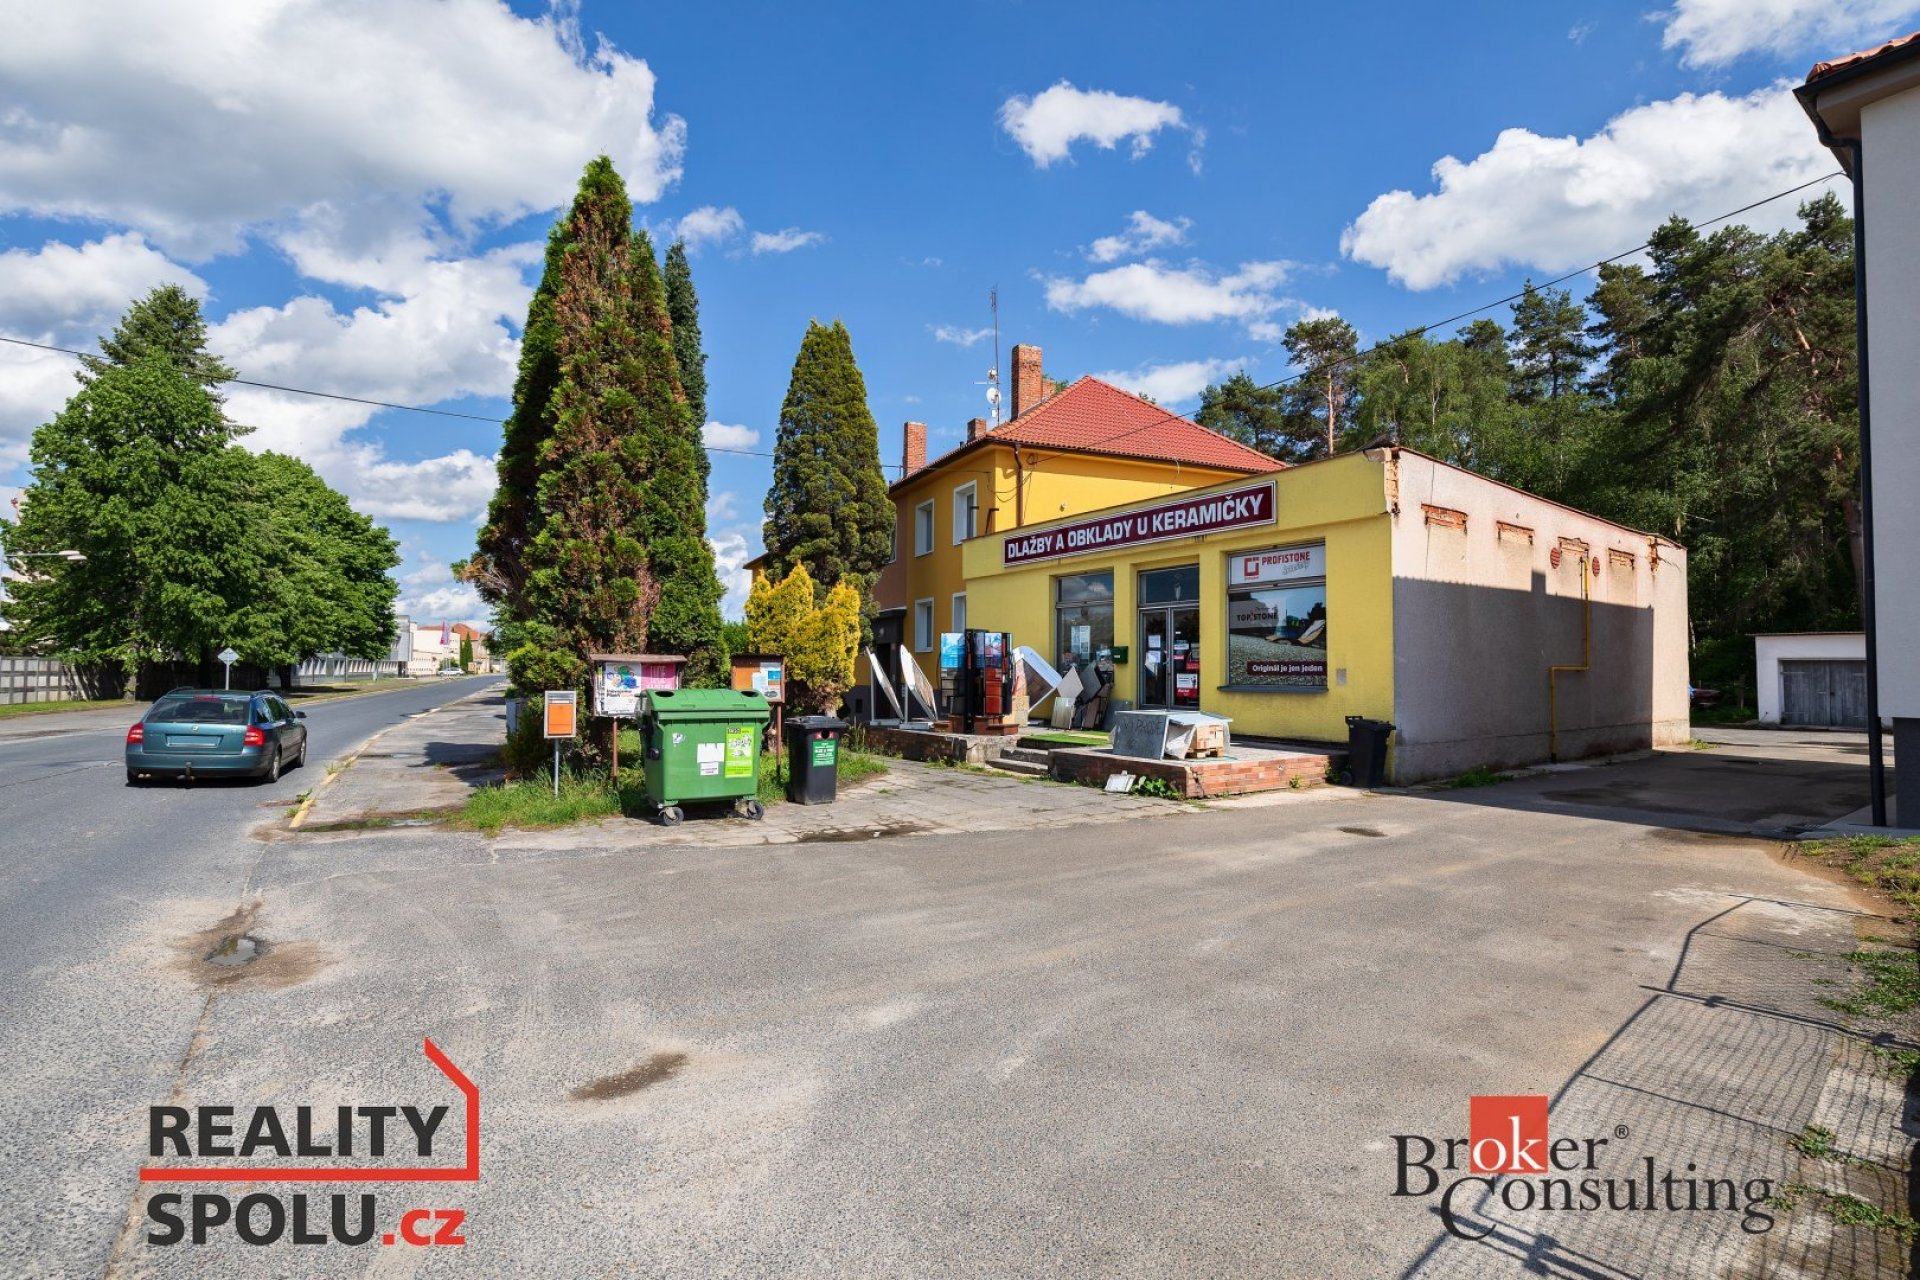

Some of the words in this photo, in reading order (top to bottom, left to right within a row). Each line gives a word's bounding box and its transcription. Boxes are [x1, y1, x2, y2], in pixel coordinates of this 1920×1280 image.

[1008, 532, 1053, 559] DLAŽBY
[1055, 533, 1065, 550] A
[1067, 519, 1133, 547] OBKLADY
[1137, 517, 1148, 535] U
[1152, 493, 1264, 533] KERAMIČKY
[1261, 551, 1311, 566] PROFISTONE
[1252, 664, 1280, 673] Originál
[1288, 665, 1301, 673] jen
[1301, 664, 1323, 673] jeden
